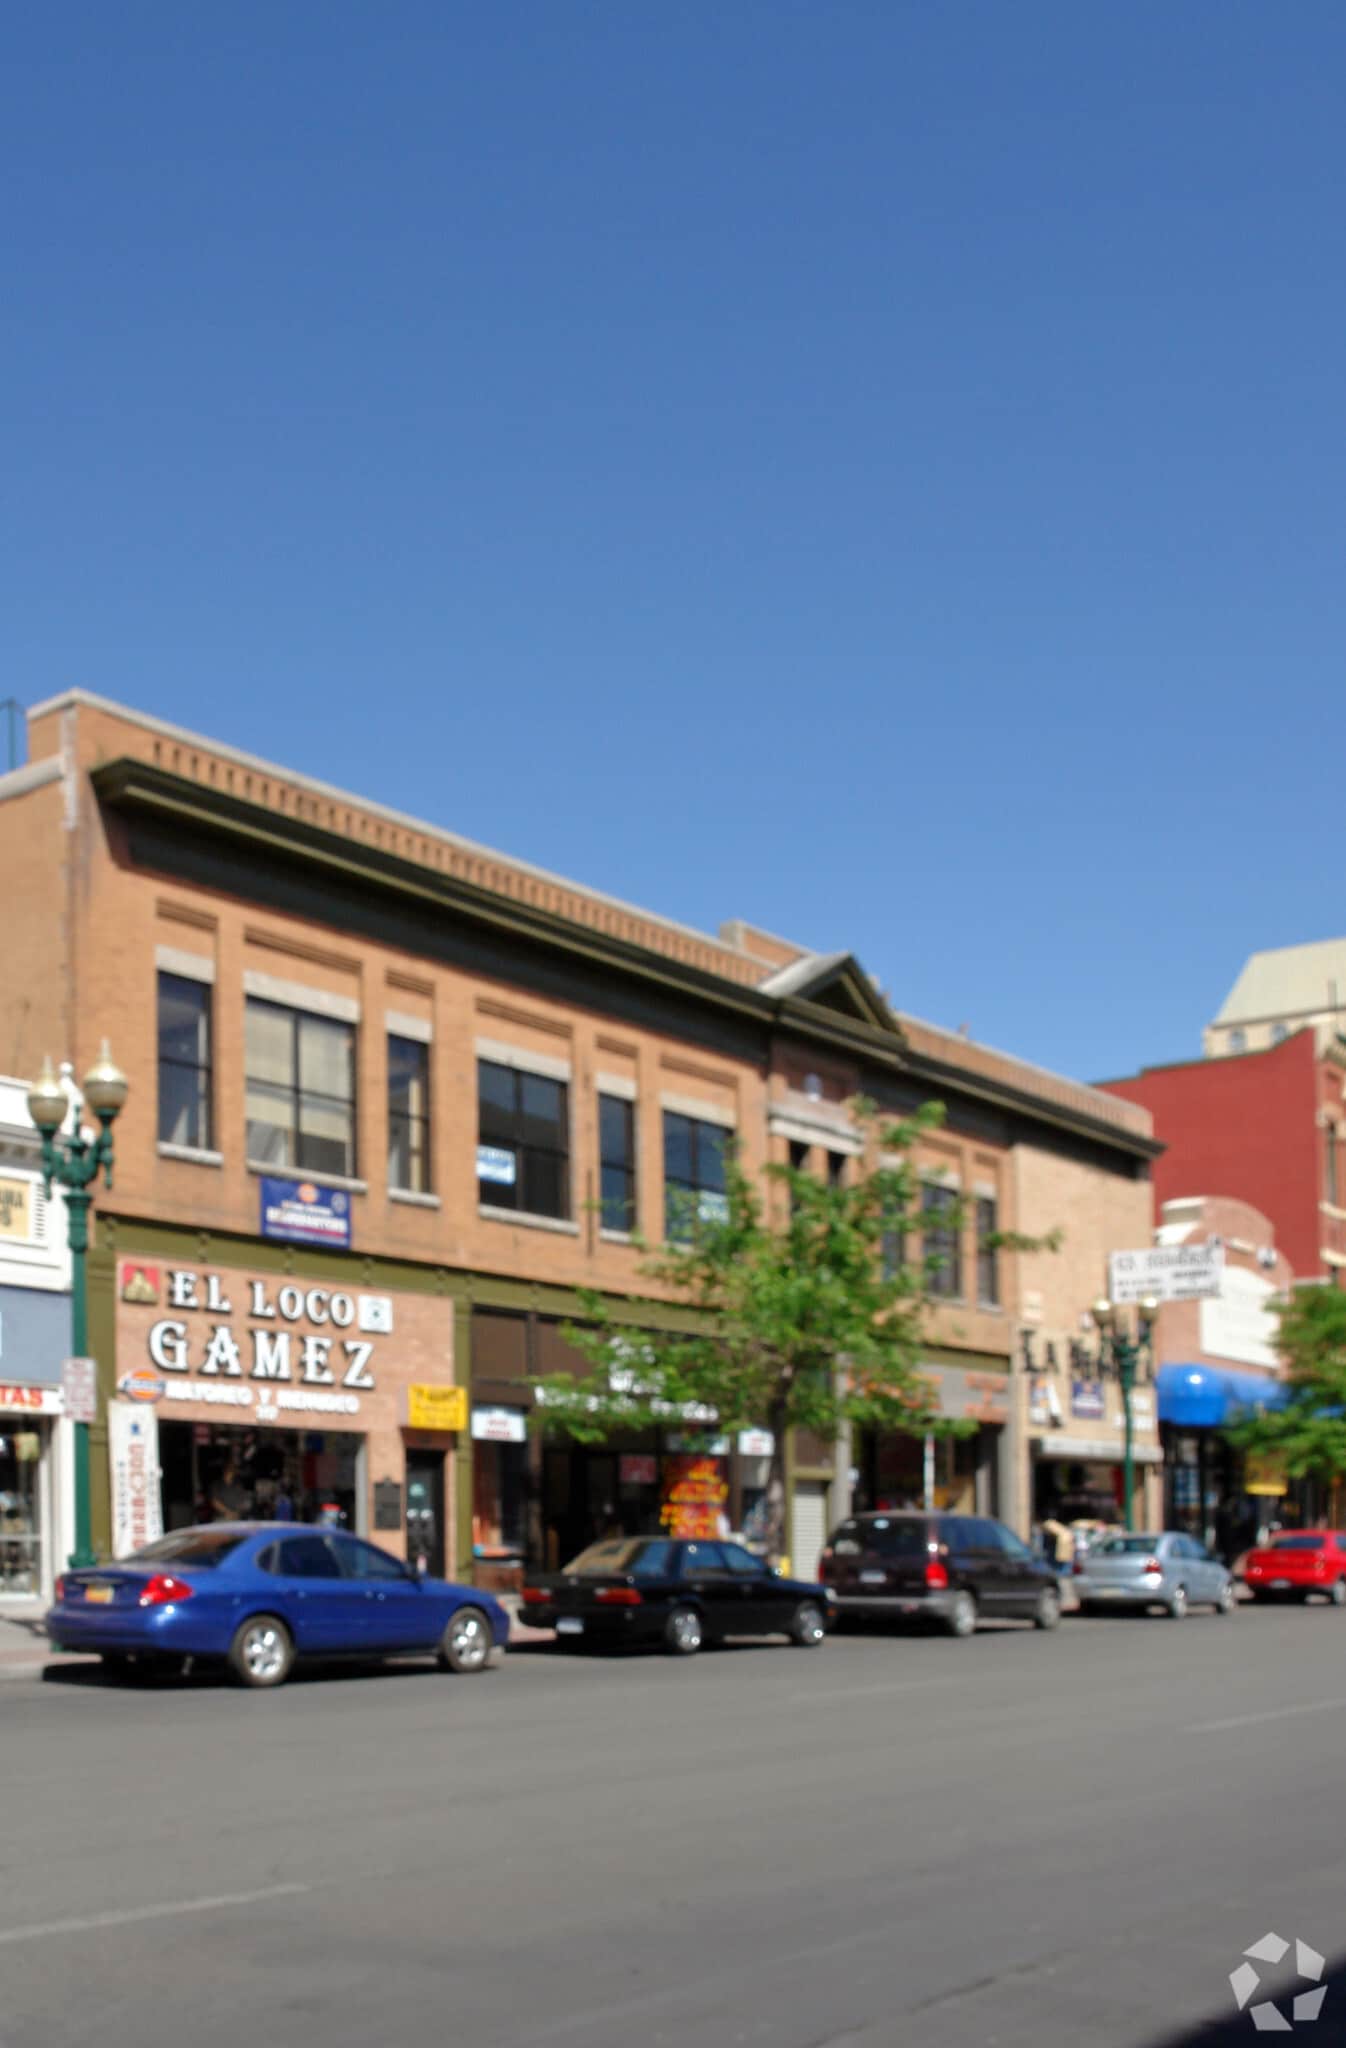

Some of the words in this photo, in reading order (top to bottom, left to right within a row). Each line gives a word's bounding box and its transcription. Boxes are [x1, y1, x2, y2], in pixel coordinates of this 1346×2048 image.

[170, 1271, 231, 1314] EL
[250, 1281, 354, 1326] LOCO
[149, 1320, 375, 1388] GAMEZ
